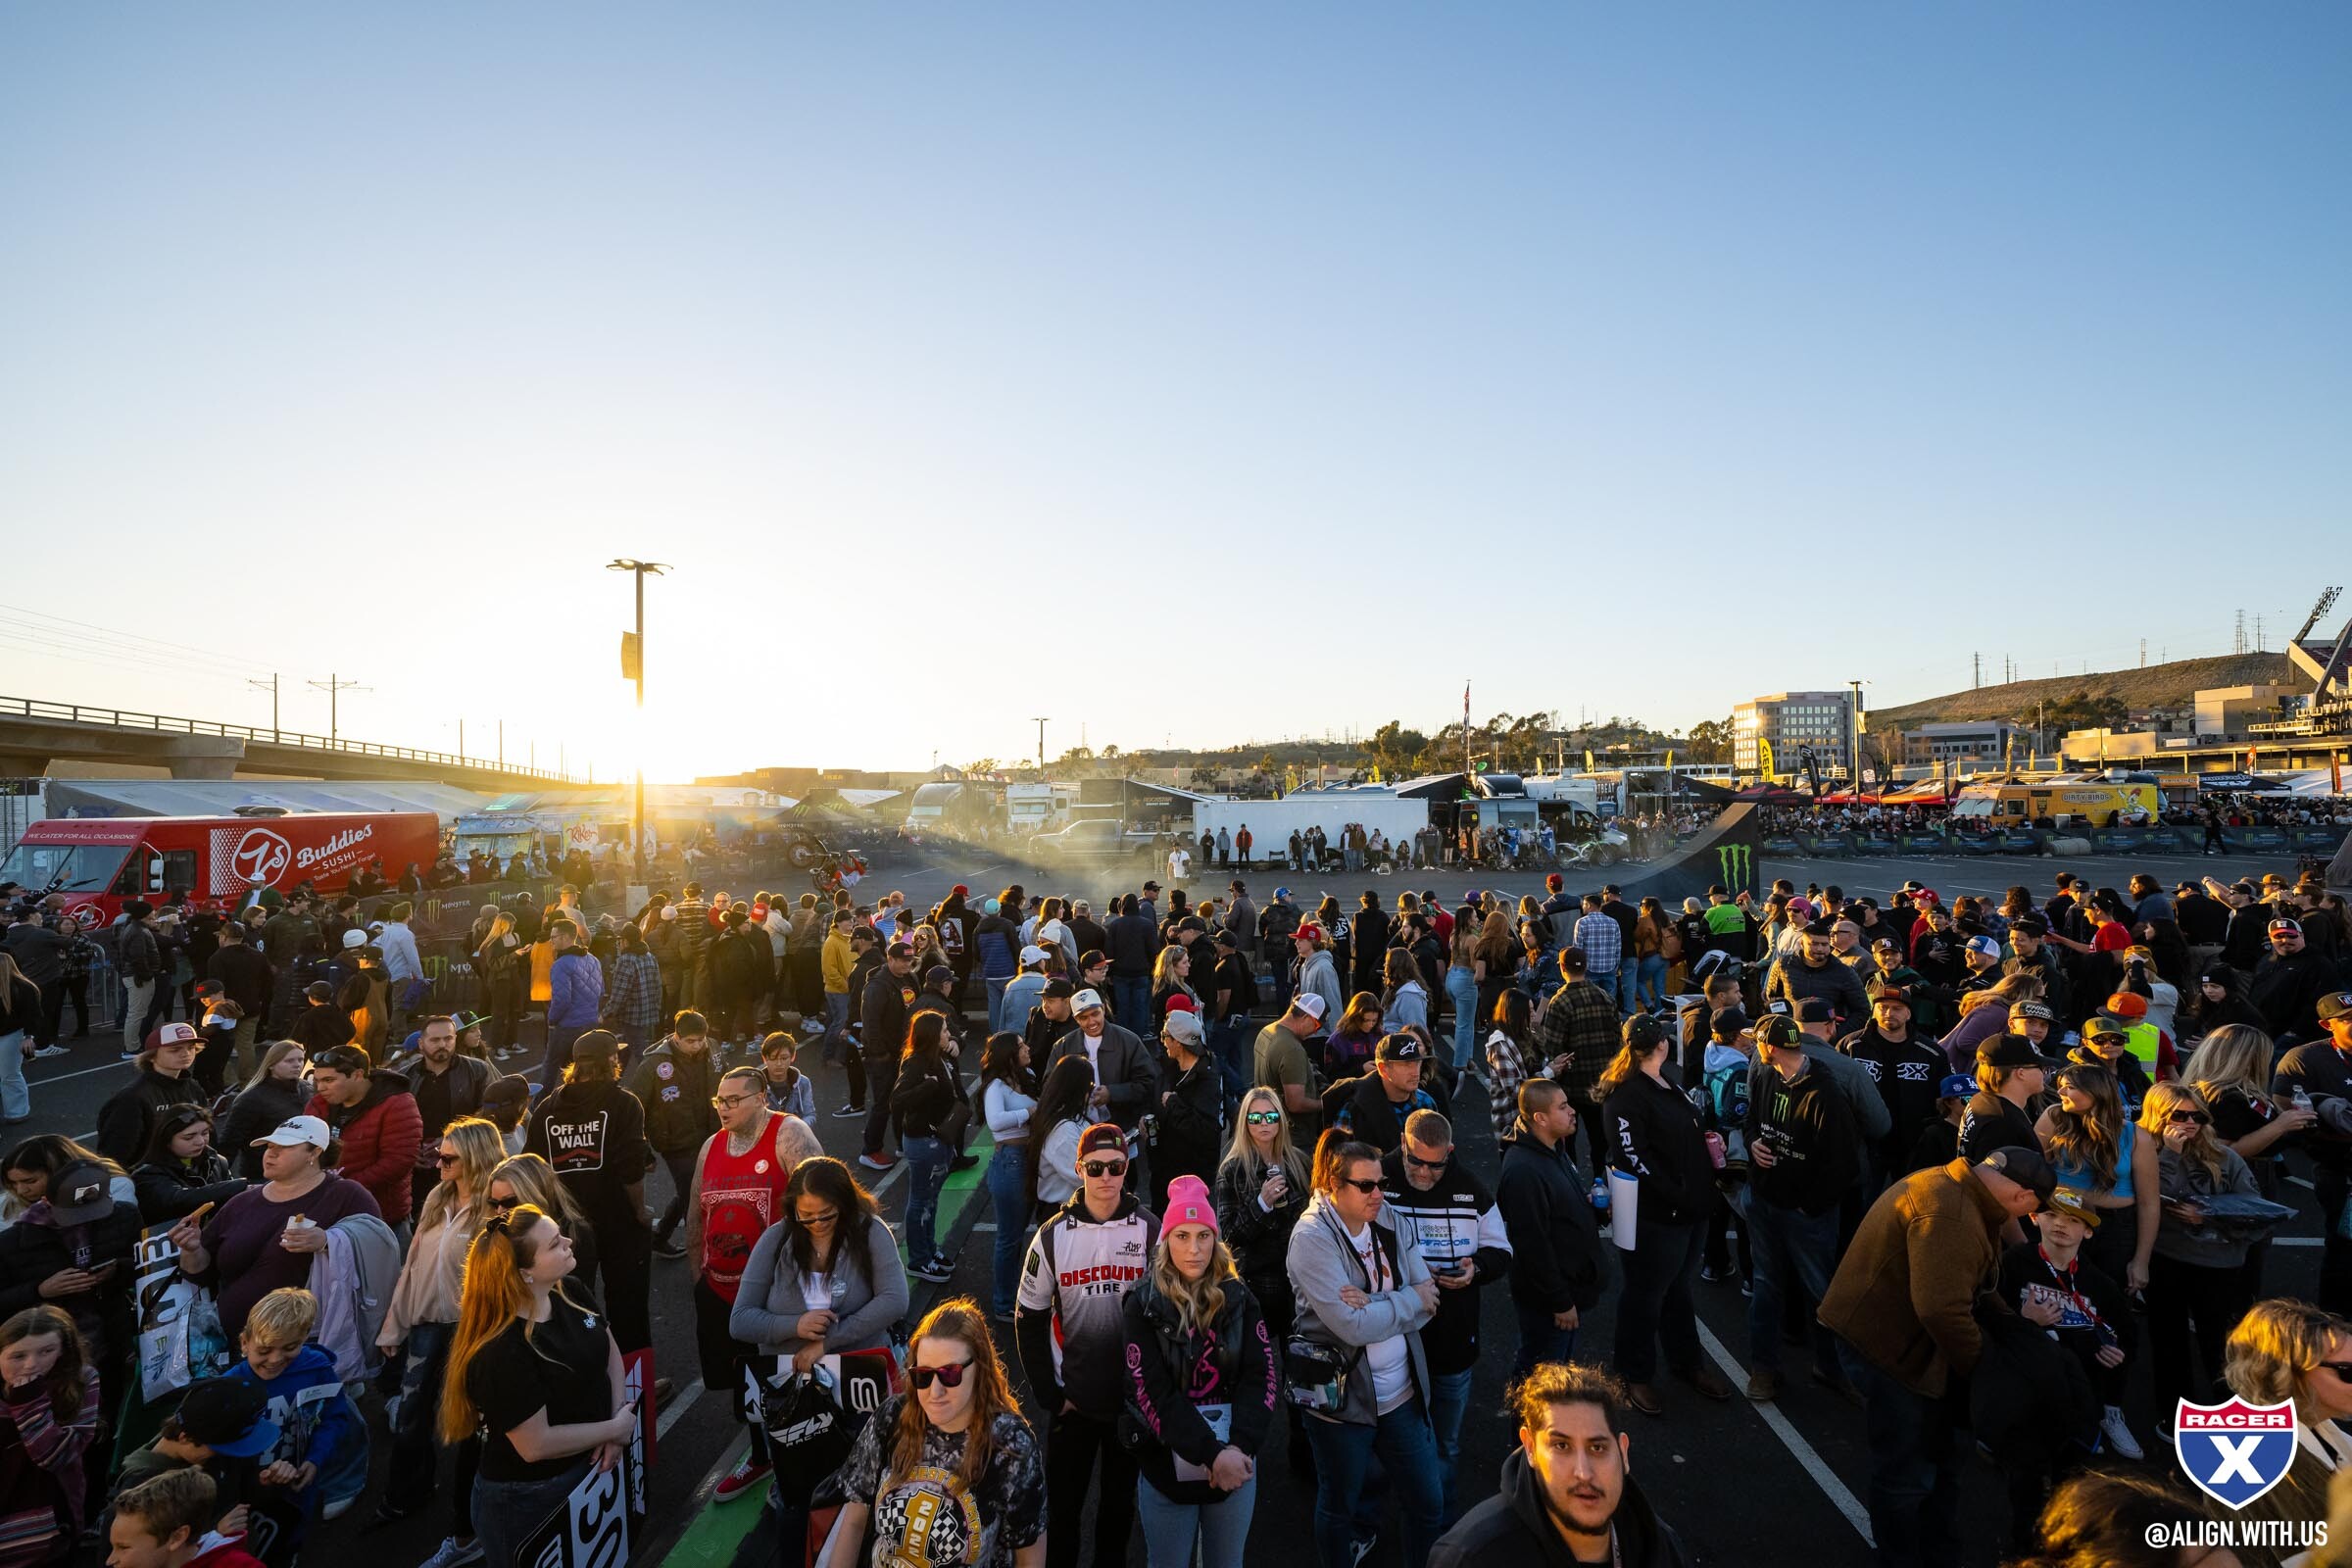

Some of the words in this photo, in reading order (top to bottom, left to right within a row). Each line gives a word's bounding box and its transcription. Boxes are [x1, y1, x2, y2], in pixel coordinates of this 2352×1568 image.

[296, 823, 373, 868] Buddies
[313, 871, 330, 882] Taste
[340, 858, 359, 872] Never
[358, 853, 377, 866] Forget
[321, 851, 356, 870] SUSHI
[441, 900, 471, 910] MONSTER
[550, 1124, 575, 1137] OFF
[578, 1120, 600, 1134] THE
[558, 1133, 595, 1150] WALL
[1617, 1116, 1650, 1176] ARIAT
[1420, 1238, 1471, 1247] PERCROSS
[1059, 1264, 1144, 1287] DISCOUNT
[1085, 1283, 1121, 1296] TIRE
[768, 1411, 834, 1444] FLY
[785, 1427, 830, 1447] RACING
